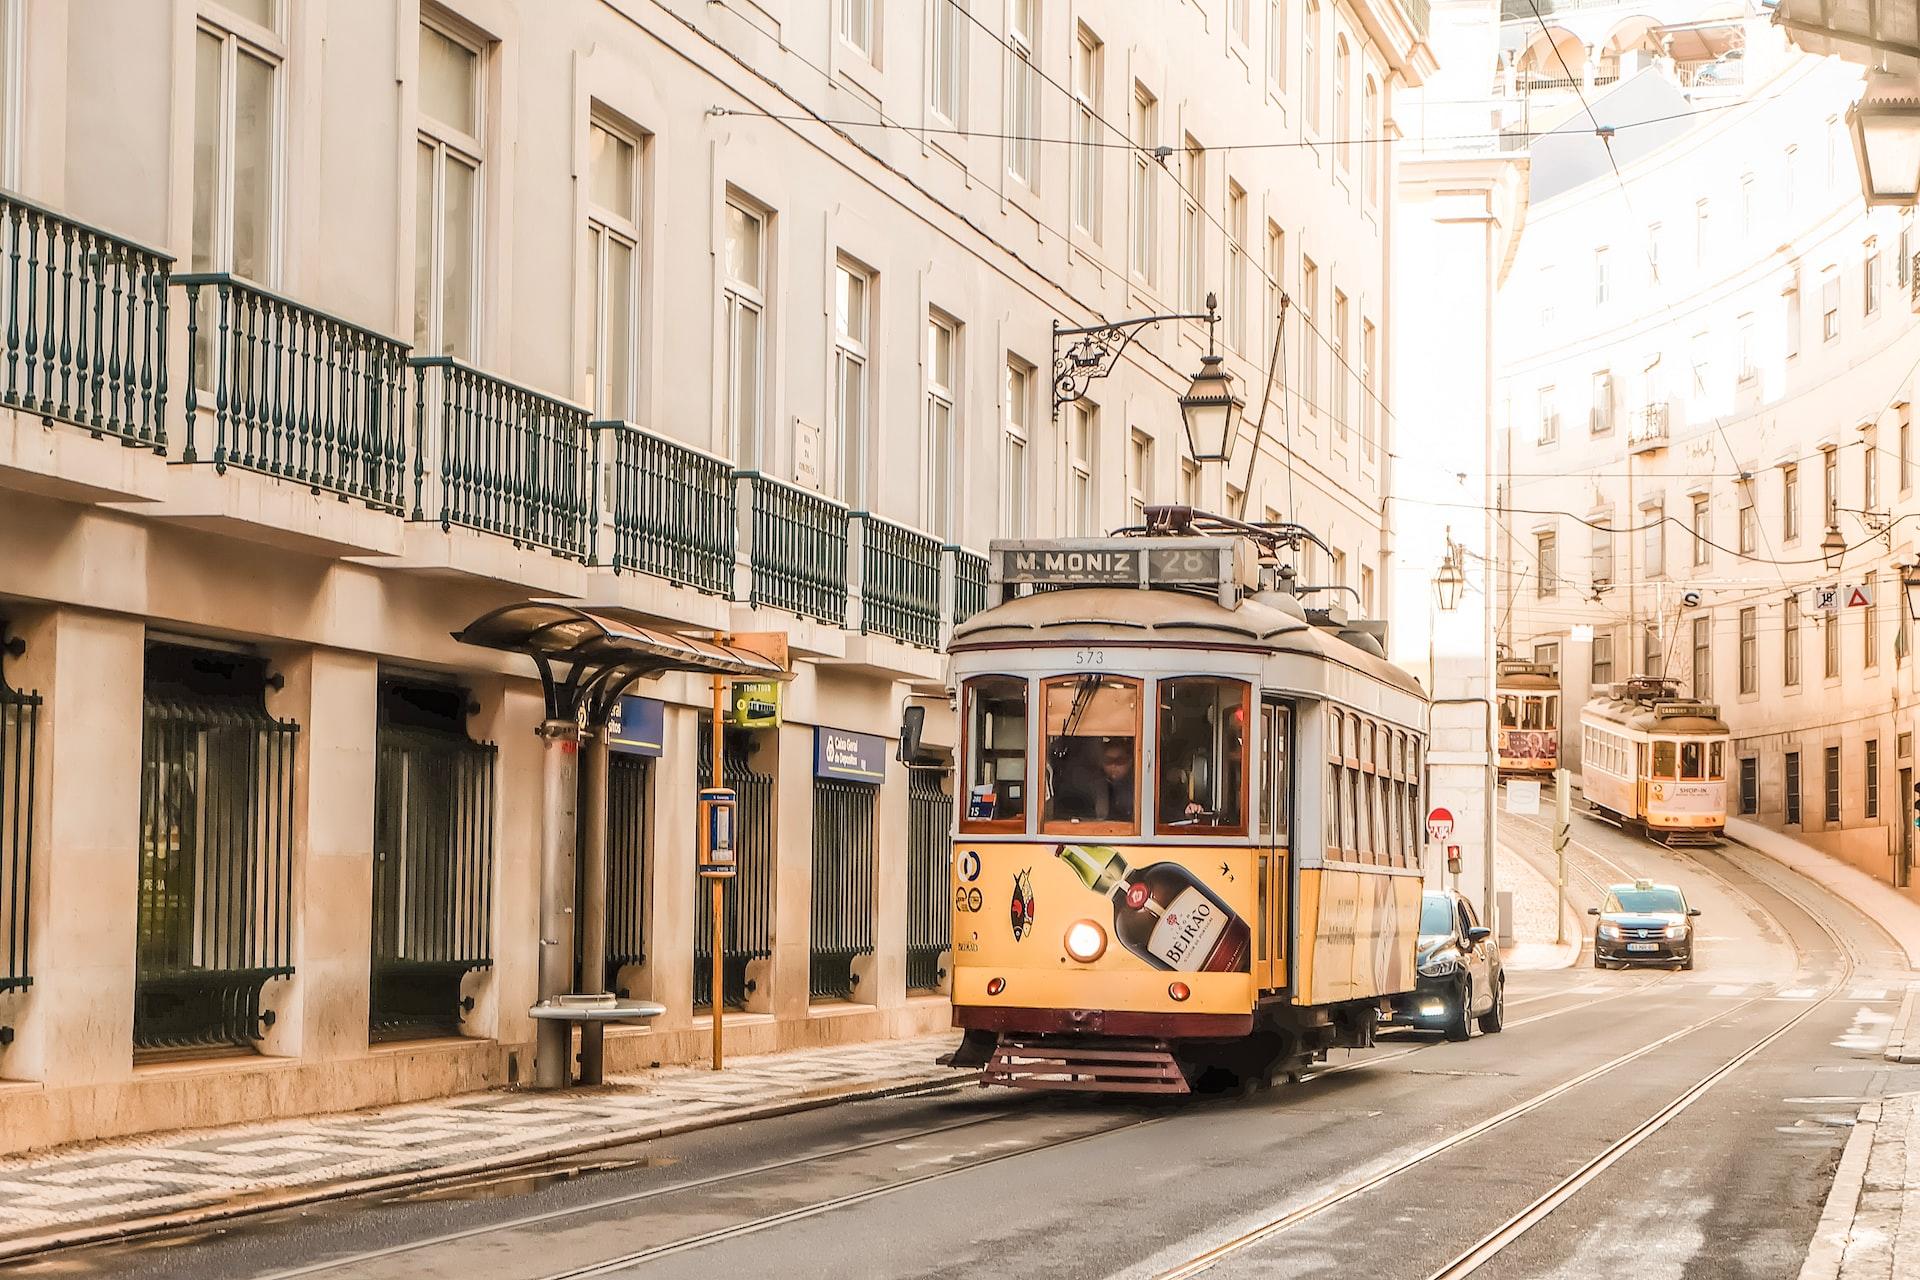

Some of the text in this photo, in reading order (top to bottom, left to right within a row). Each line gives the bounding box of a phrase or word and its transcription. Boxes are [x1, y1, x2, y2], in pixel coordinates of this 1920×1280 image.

[1162, 551, 1204, 573] 28
[1684, 593, 1700, 607] S
[1076, 651, 1104, 664] 573
[834, 736, 858, 753] Caixa Geral
[970, 807, 980, 817] 15
[1166, 903, 1210, 964] BEIRÃO
